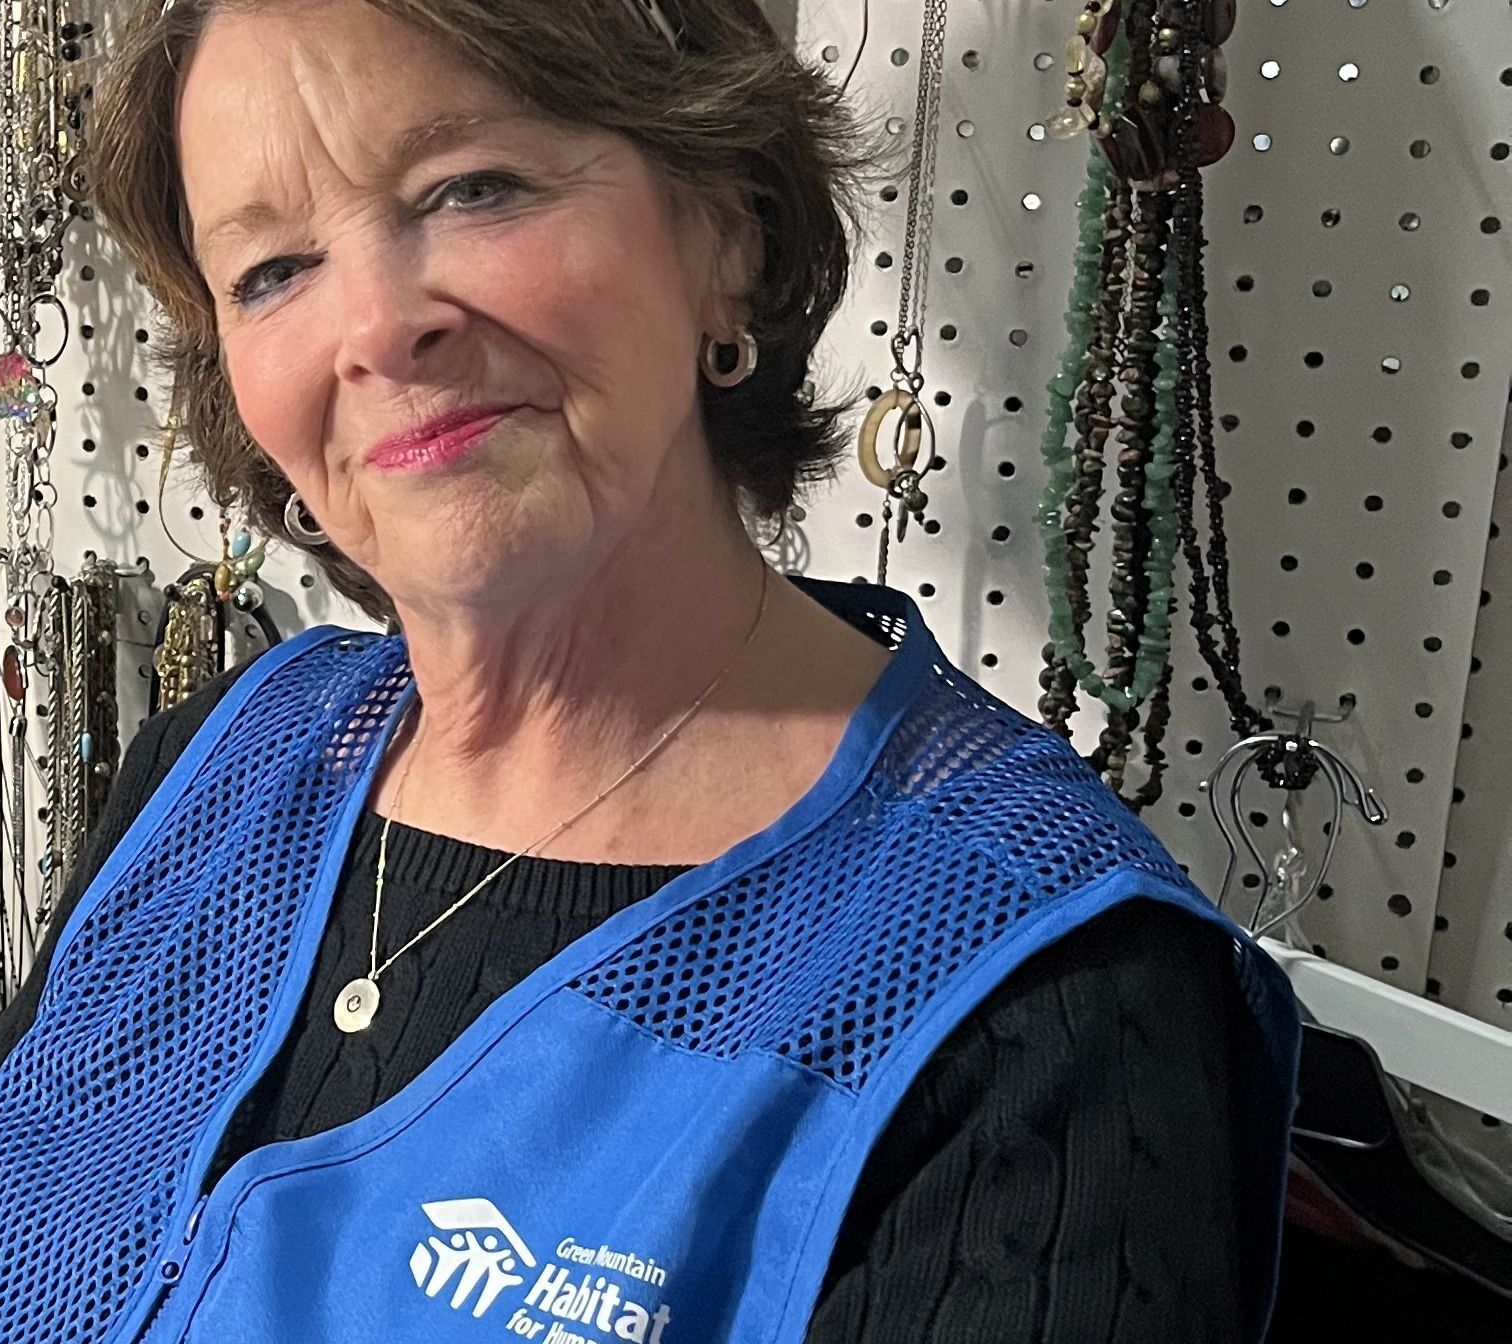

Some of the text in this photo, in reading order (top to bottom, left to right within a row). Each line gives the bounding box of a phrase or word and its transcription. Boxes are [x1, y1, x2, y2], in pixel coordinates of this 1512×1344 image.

[556, 1237, 666, 1287] Green Mountain
[506, 1308, 545, 1340] for
